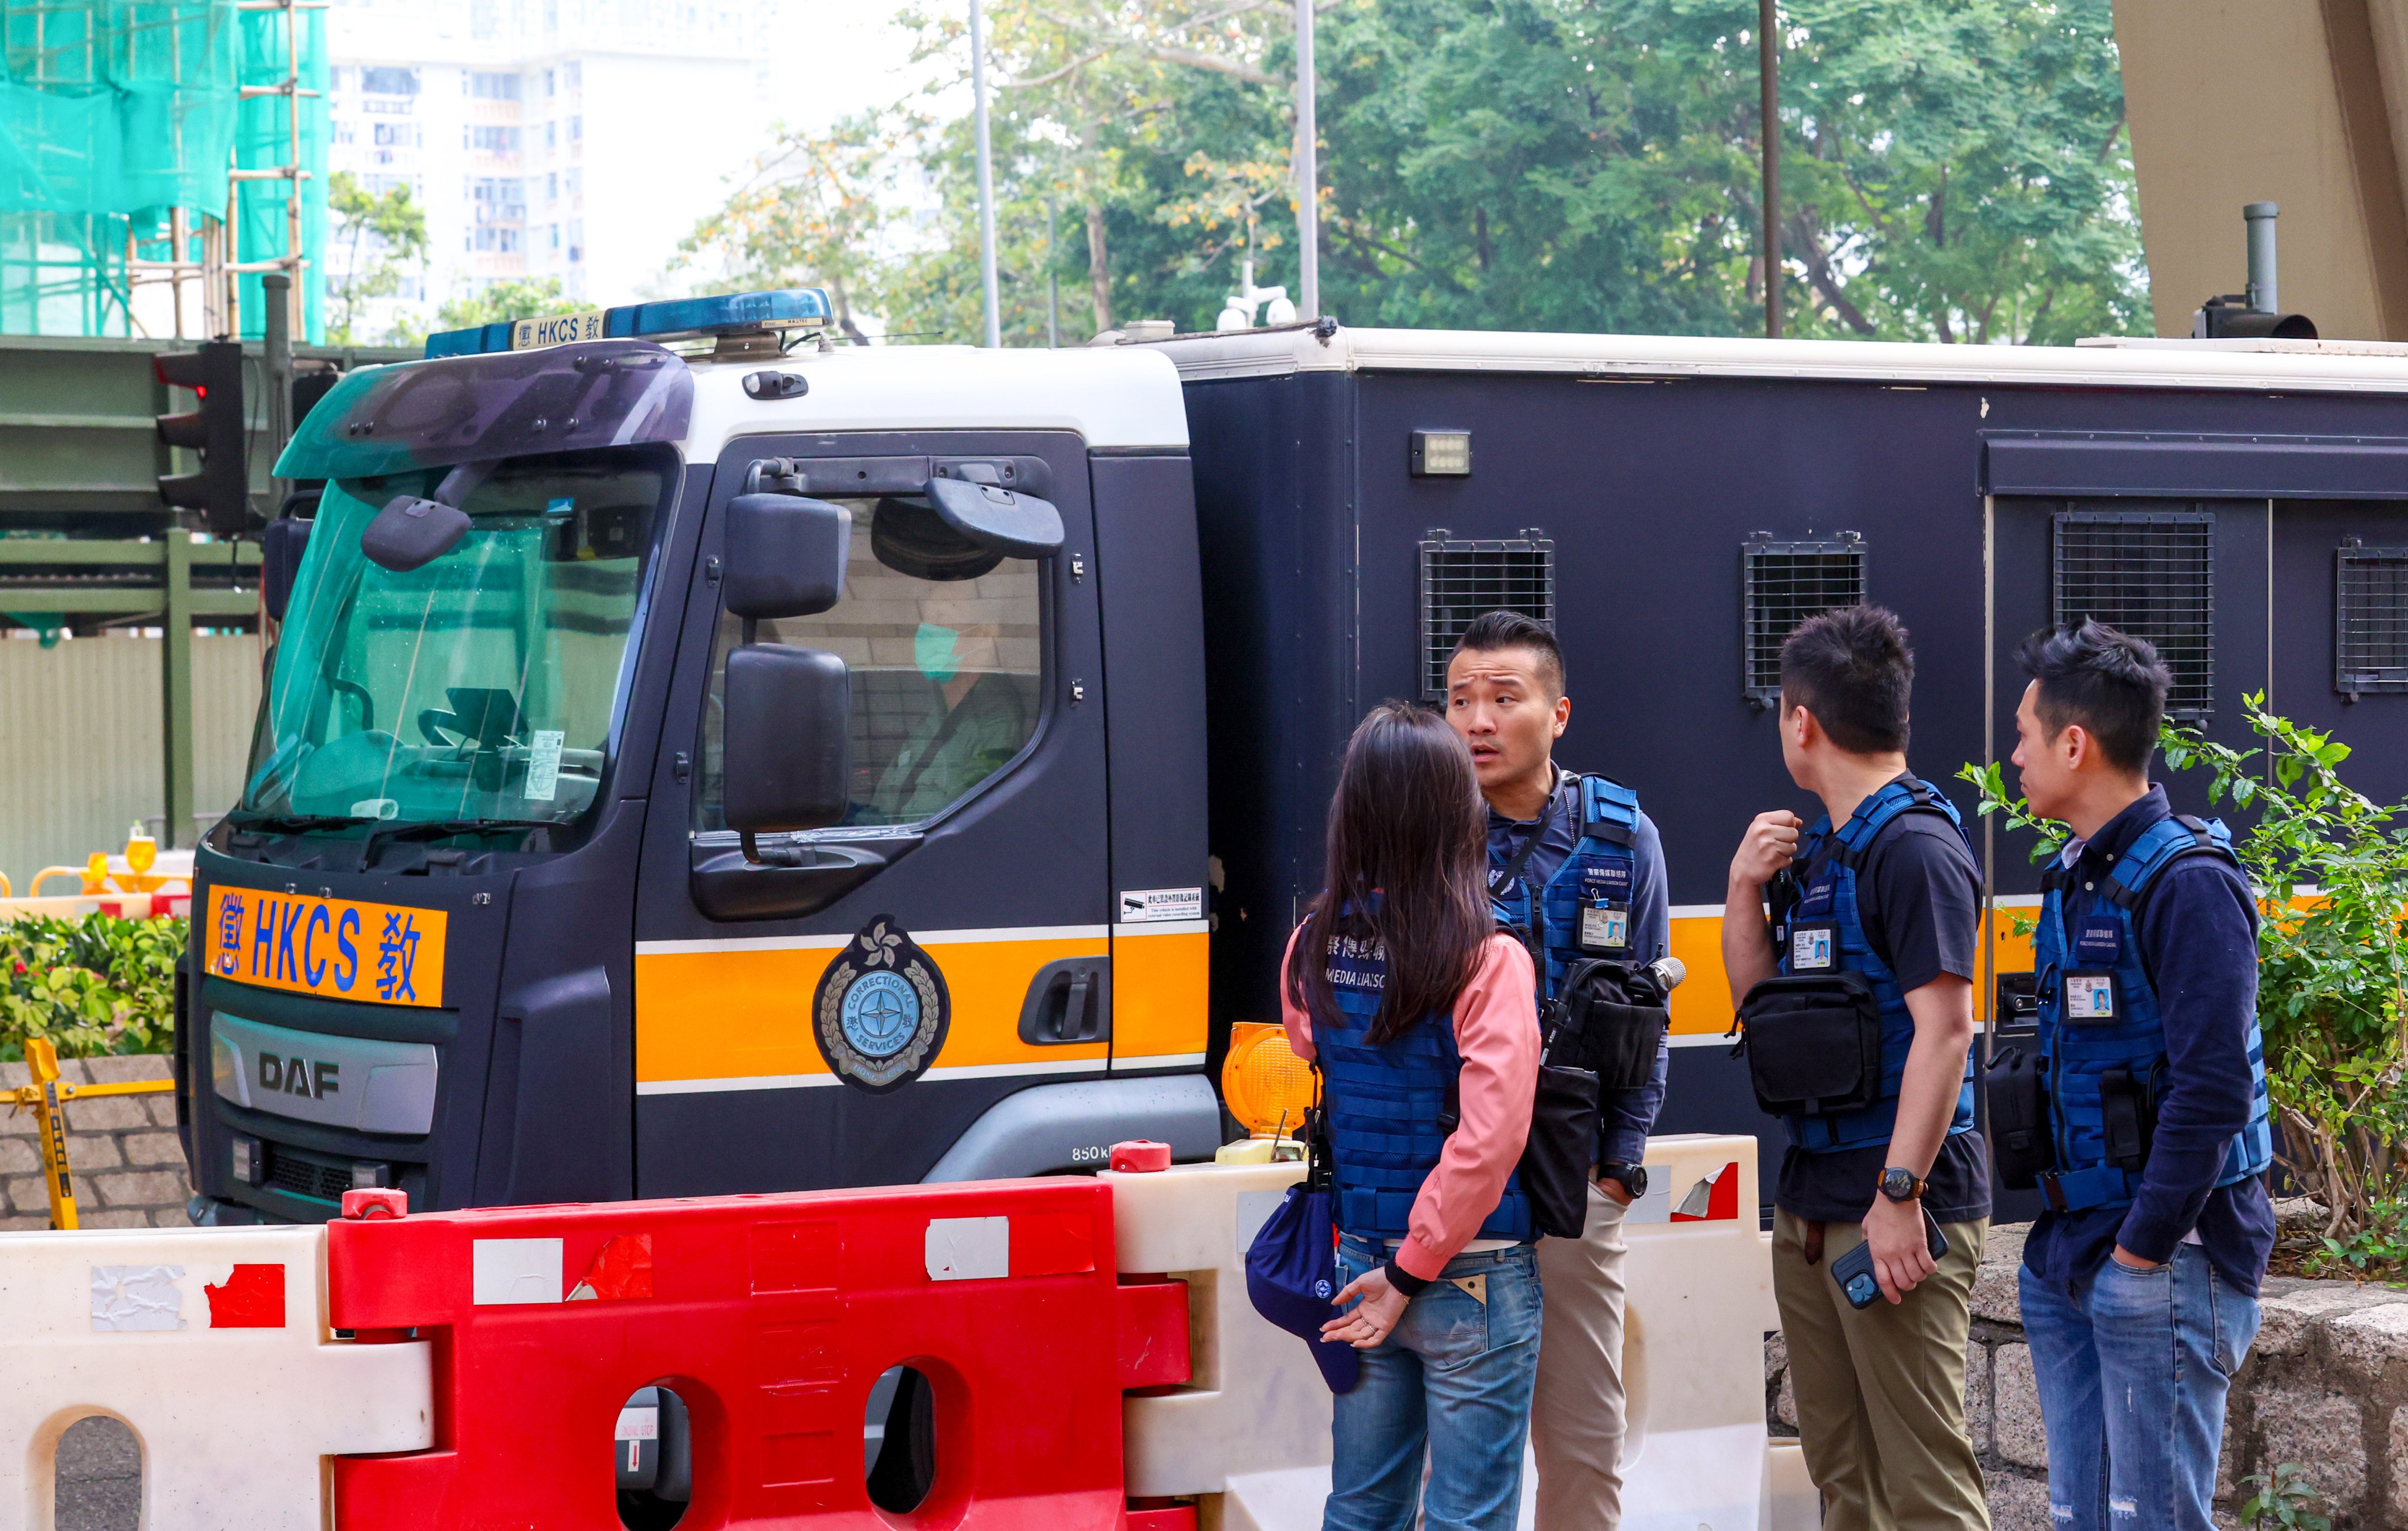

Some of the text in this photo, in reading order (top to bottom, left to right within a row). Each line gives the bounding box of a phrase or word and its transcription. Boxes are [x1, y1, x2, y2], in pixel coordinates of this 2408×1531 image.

[538, 317, 578, 345] HKCS
[252, 899, 360, 992] HKCS
[1325, 968, 1356, 985] MEDIA
[848, 976, 914, 1010] CORRECTIONAL
[856, 1032, 905, 1051] SERVICES
[259, 1051, 340, 1099] DAF
[853, 1062, 907, 1082] HONG KONG
[1072, 1146, 1099, 1161] 850
[641, 1425, 654, 1436] STOP
